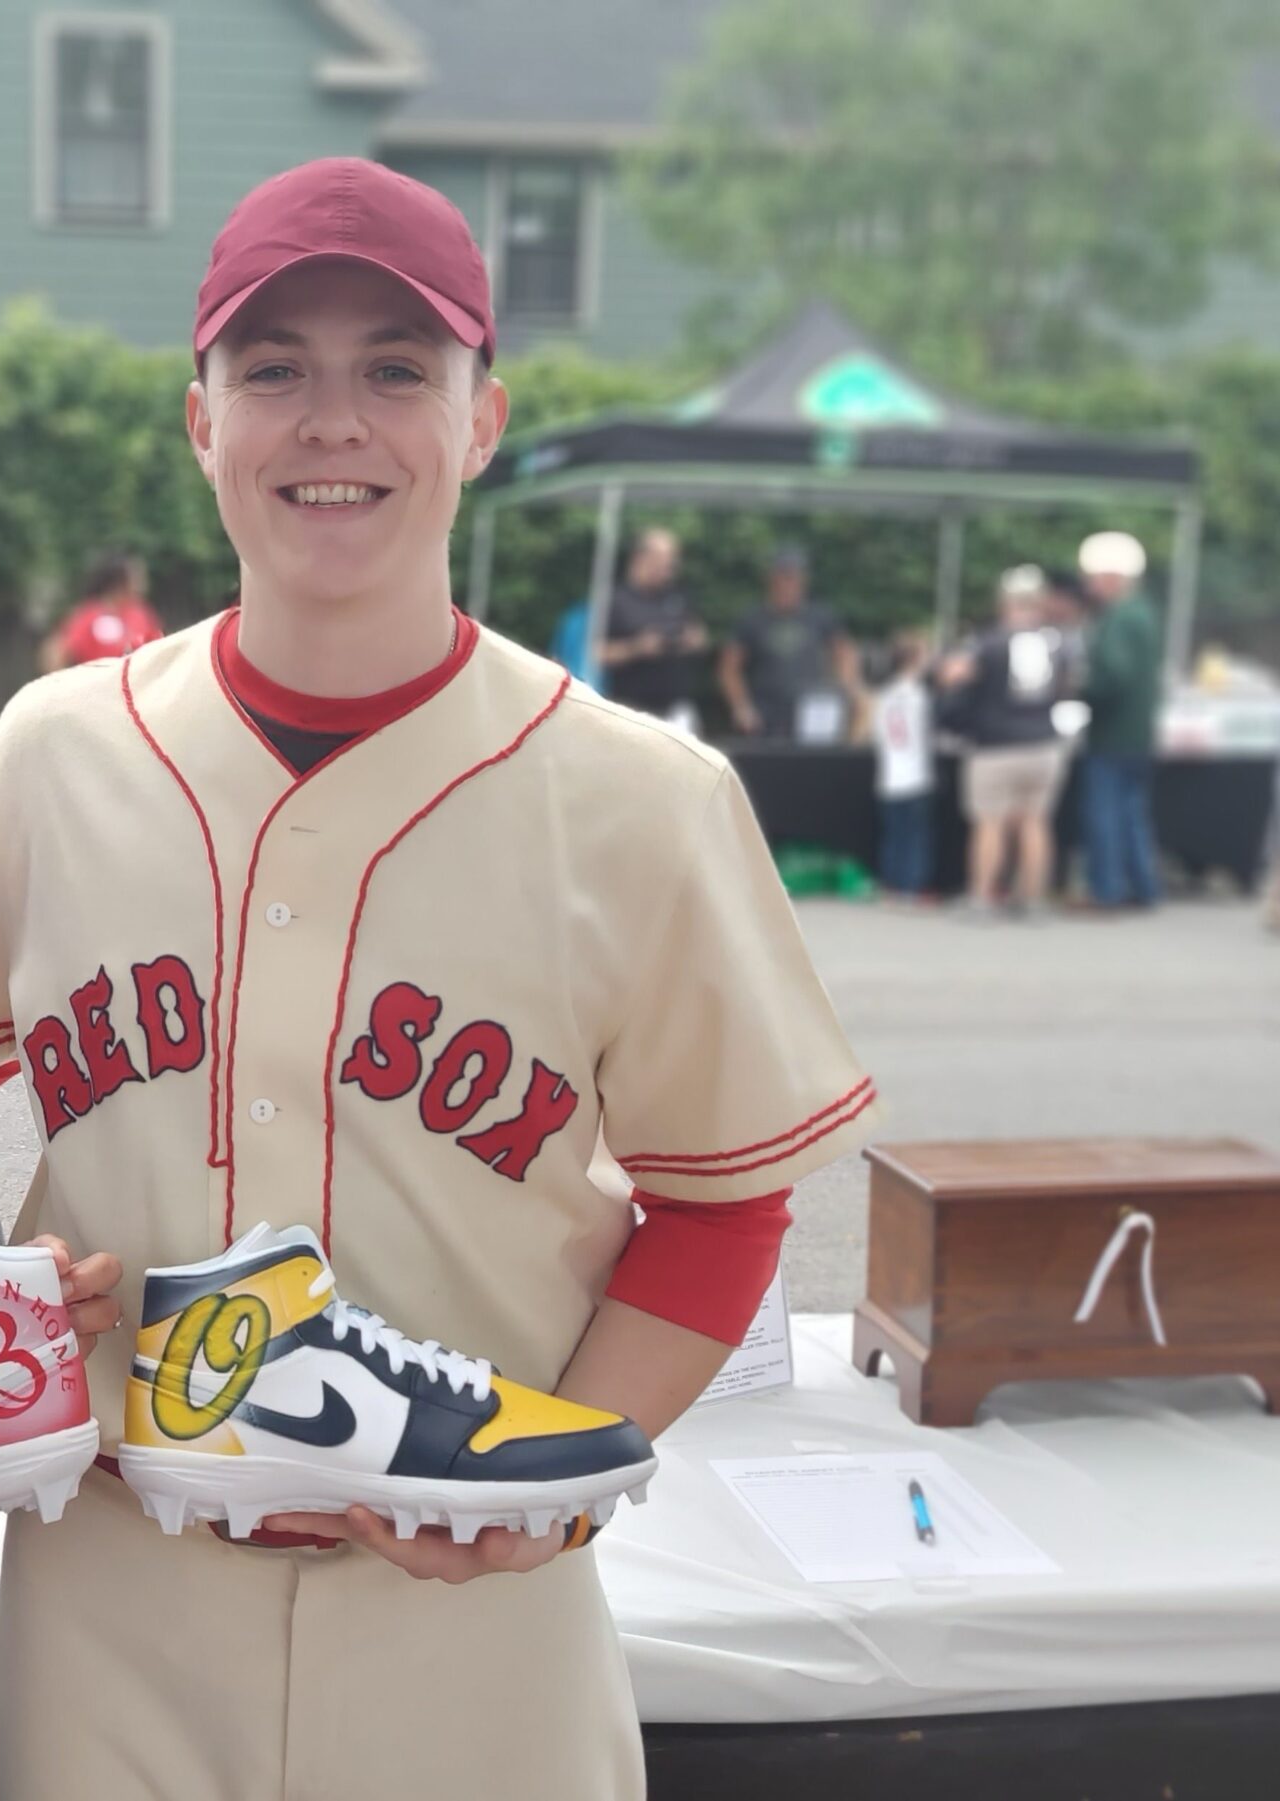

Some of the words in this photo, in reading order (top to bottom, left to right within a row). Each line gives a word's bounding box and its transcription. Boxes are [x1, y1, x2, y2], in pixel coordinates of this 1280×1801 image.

[23, 954, 205, 1143] RED
[340, 981, 579, 1182] SOX
[30, 1296, 76, 1393] HOME
